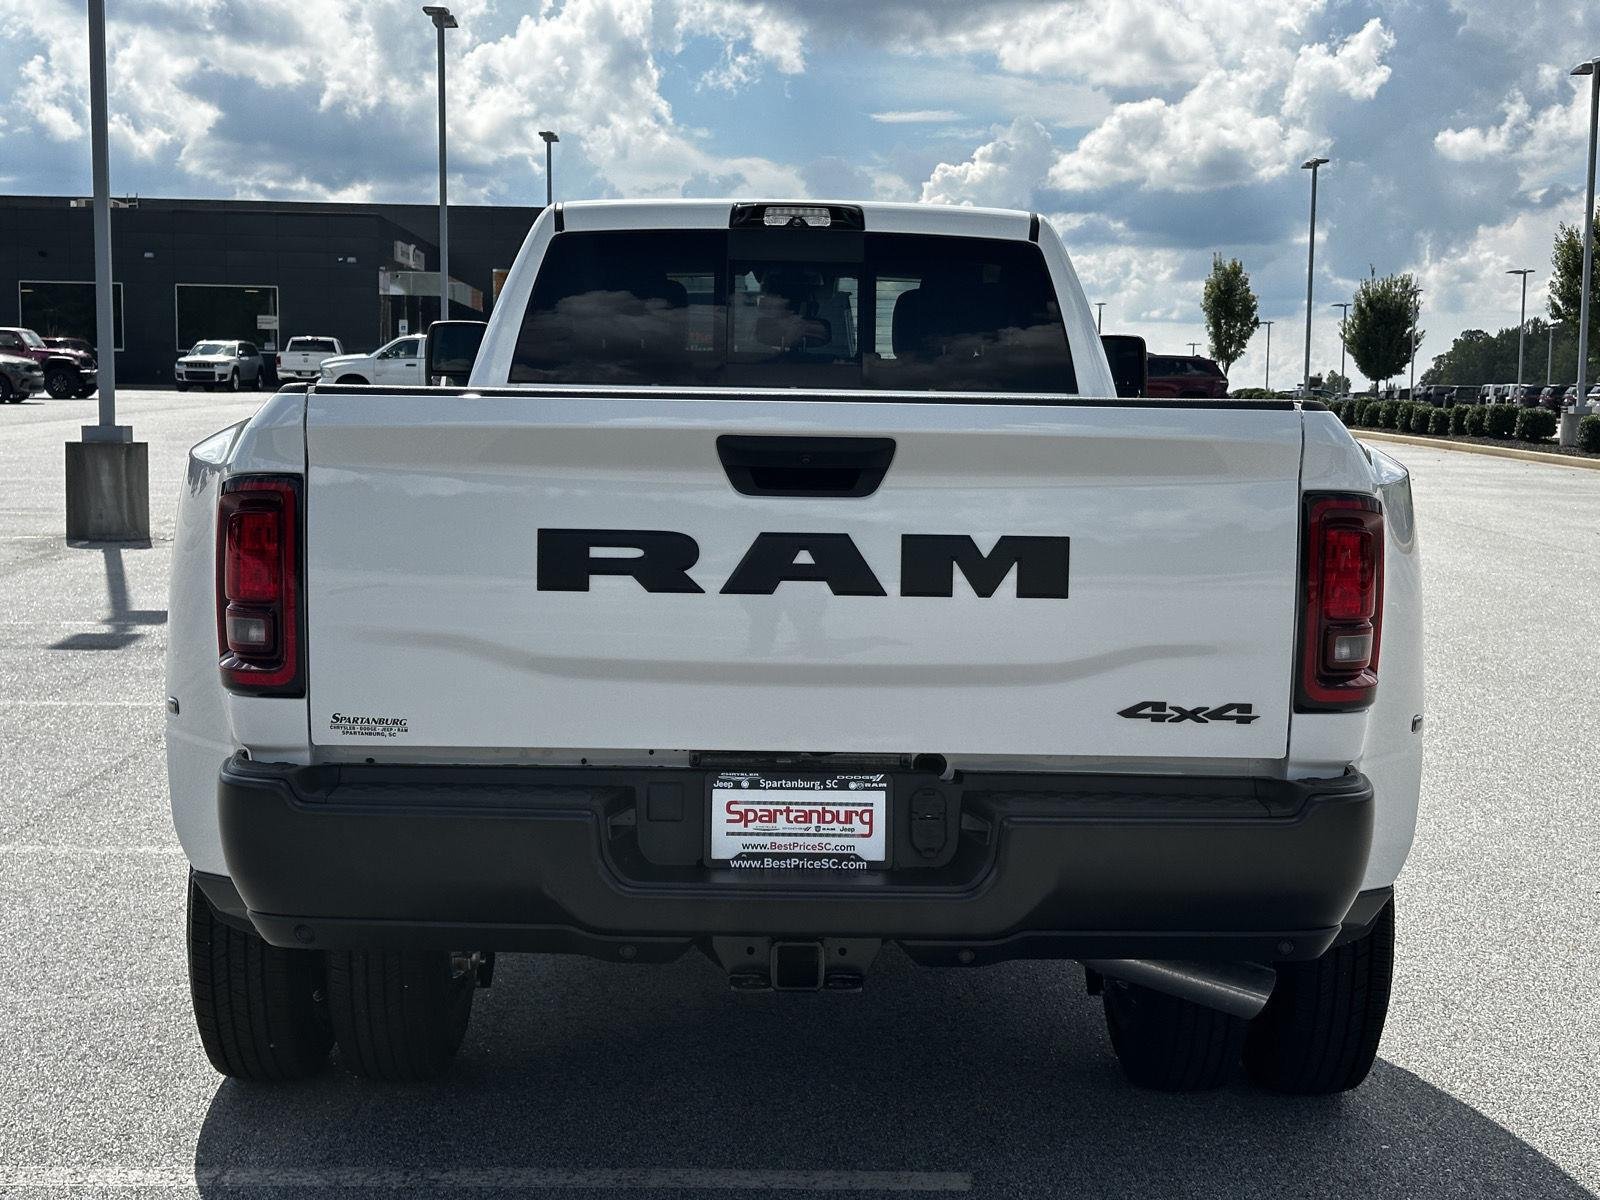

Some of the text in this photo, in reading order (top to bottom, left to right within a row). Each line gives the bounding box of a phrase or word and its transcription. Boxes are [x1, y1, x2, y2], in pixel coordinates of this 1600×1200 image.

[537, 528, 1070, 599] RAM
[1116, 701, 1261, 724] 4x4
[713, 780, 734, 789] Jeep
[759, 779, 839, 790] Spartanburg, SC
[725, 800, 874, 839] Spartanburg
[839, 825, 856, 833] Jeep
[741, 841, 856, 852] www.BestPriceSC.com
[729, 858, 867, 870] www.BestPriceSC.com
